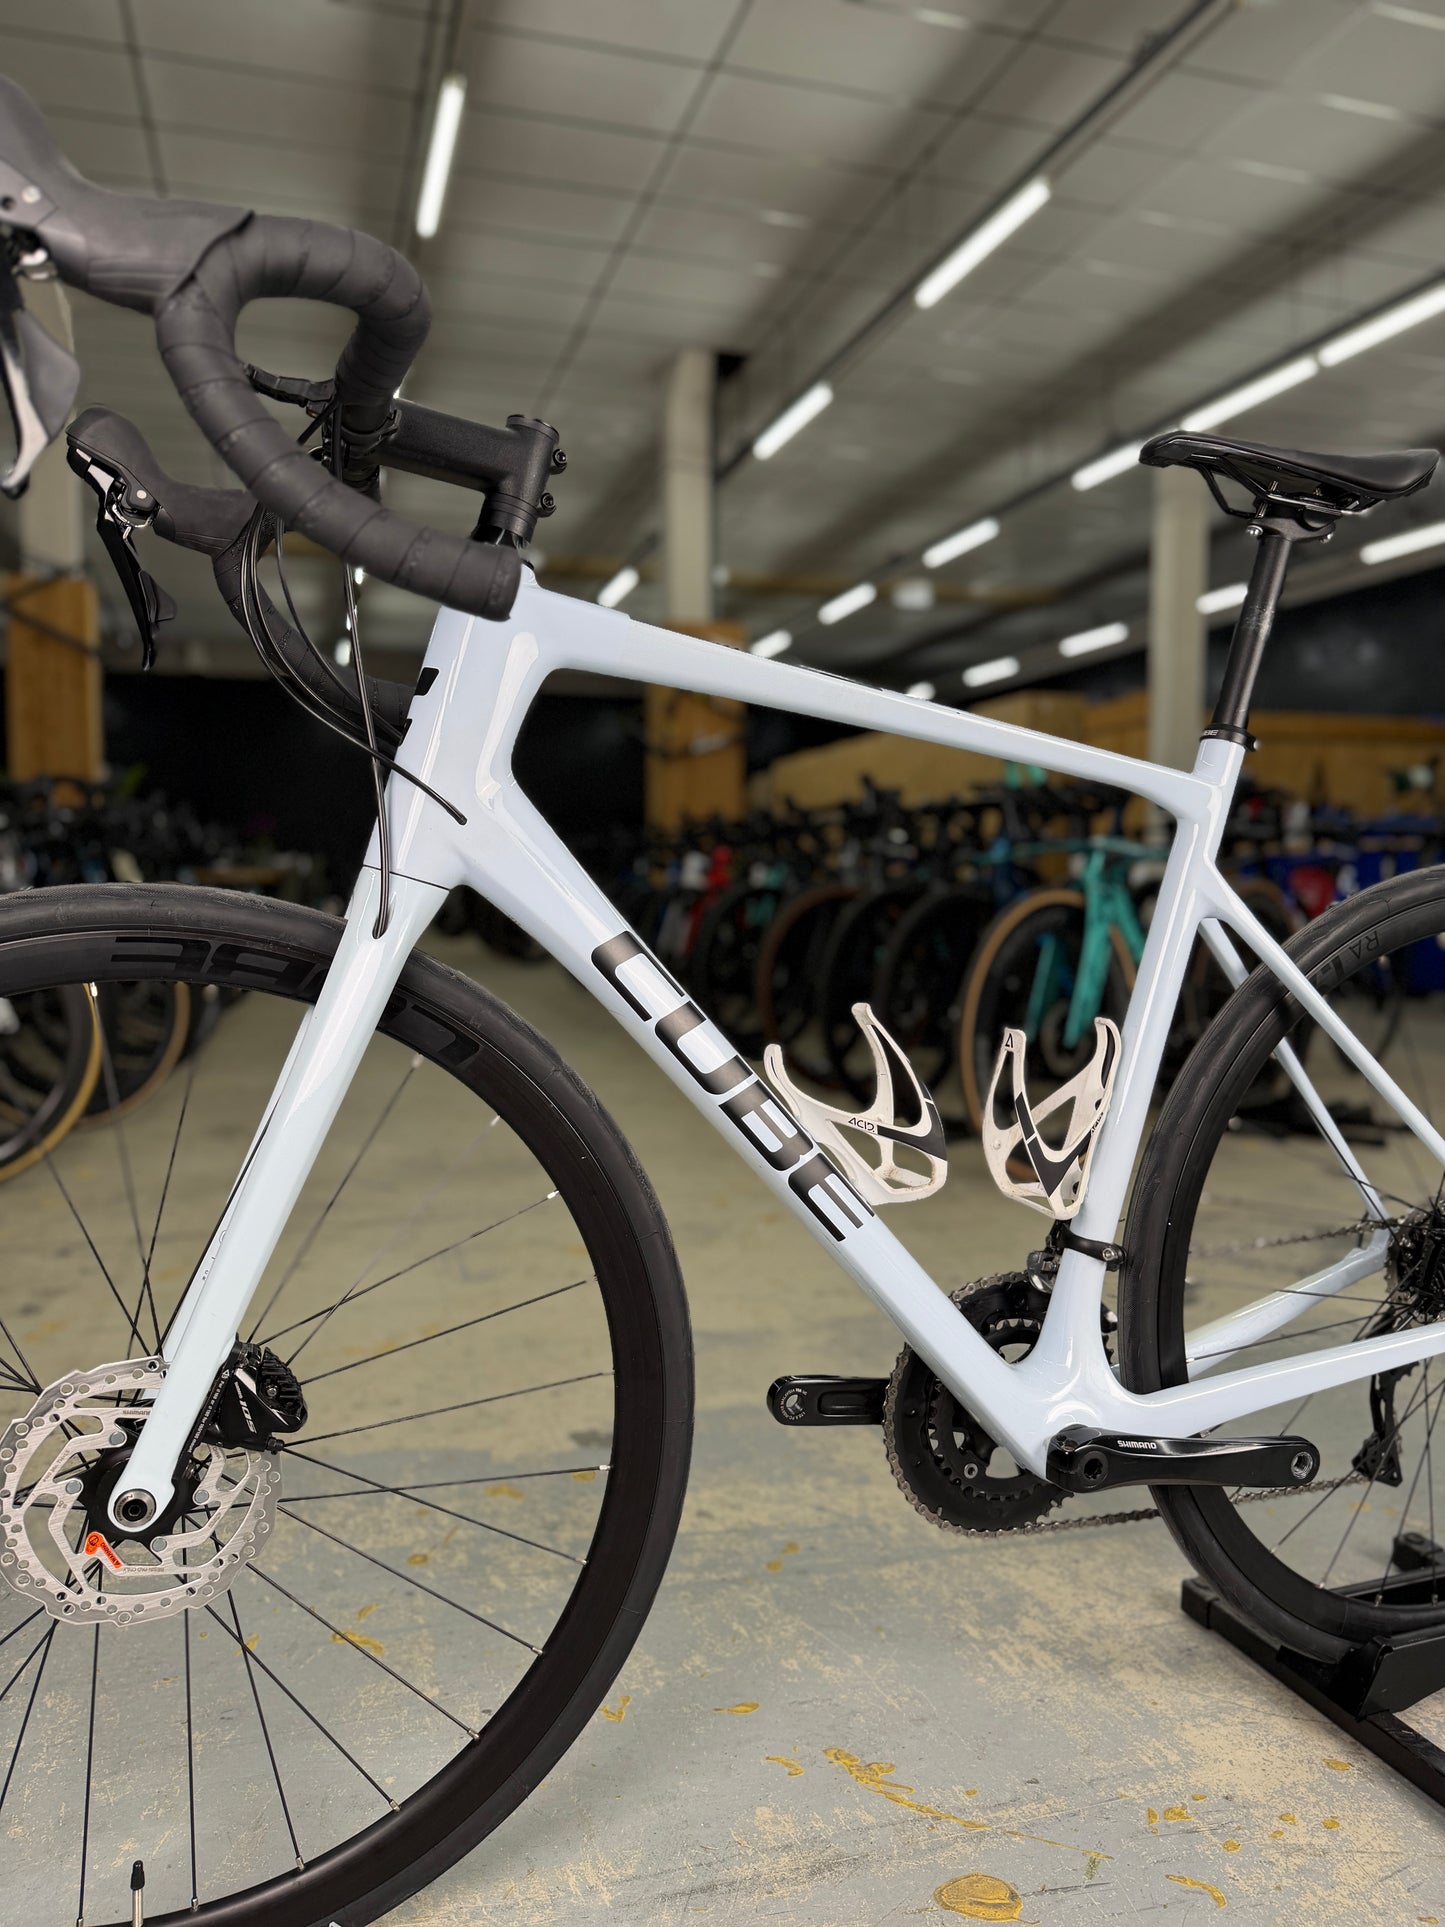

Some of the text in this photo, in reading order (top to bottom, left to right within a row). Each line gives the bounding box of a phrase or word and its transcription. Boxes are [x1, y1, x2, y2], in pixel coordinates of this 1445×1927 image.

[591, 930, 875, 1242] CUBE
[240, 1400, 257, 1434] 105
[1117, 1440, 1157, 1450] SHIMANO
